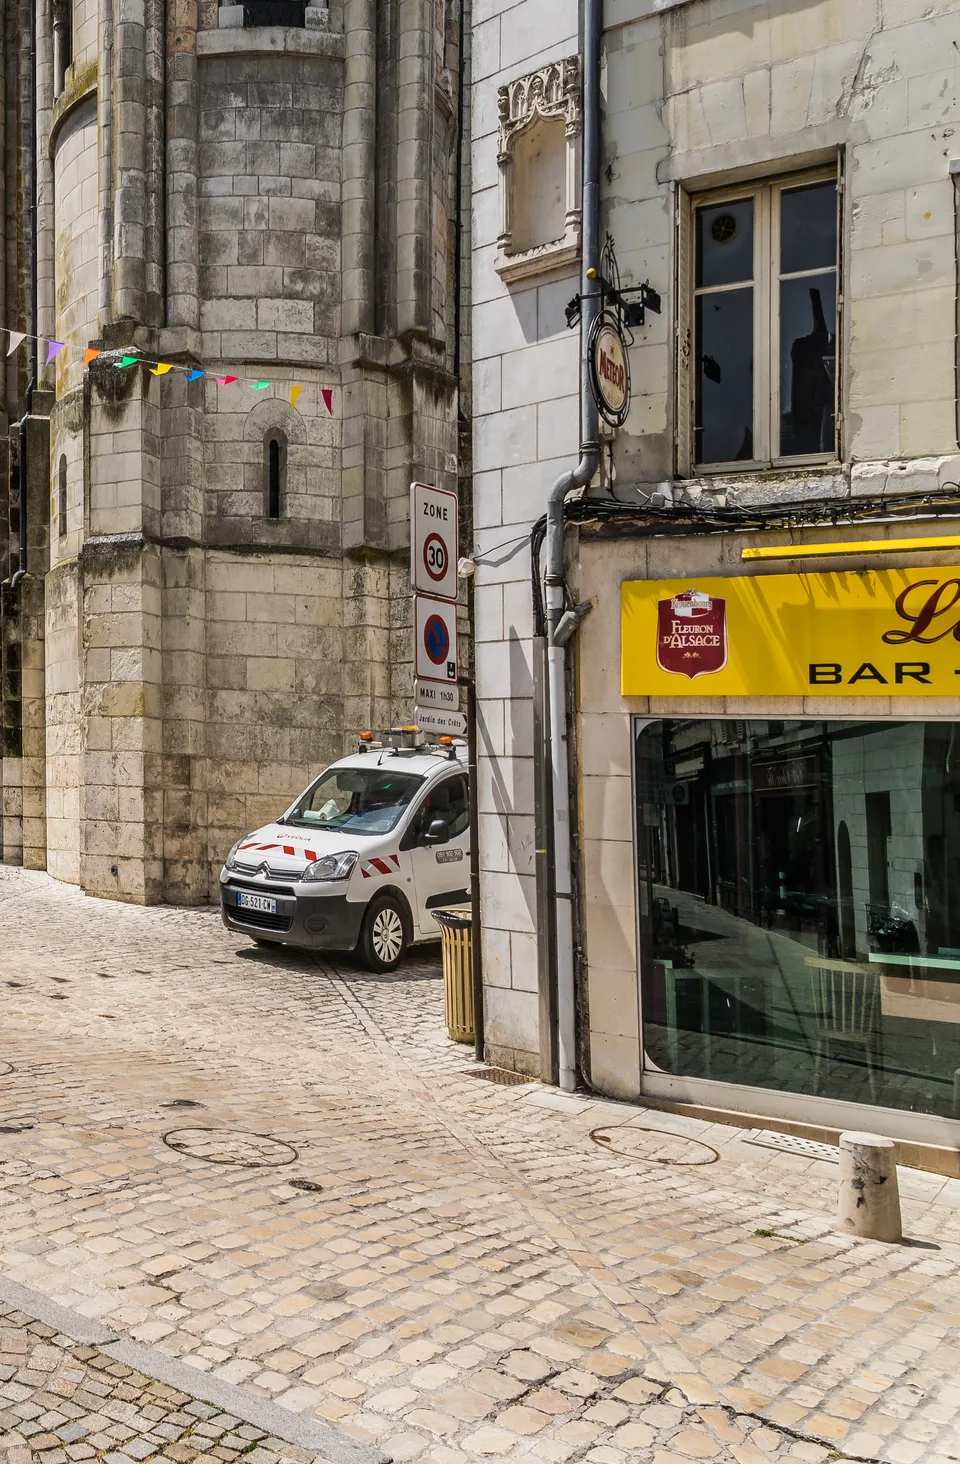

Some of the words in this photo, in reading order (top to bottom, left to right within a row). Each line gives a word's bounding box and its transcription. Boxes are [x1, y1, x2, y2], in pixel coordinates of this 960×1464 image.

[600, 348, 625, 394] METEOR
[423, 502, 448, 521] ZONE
[428, 545, 444, 569] 30
[670, 598, 713, 611] Kronenbourg
[882, 578, 960, 644] L
[671, 620, 714, 634] FLEURON
[808, 662, 933, 685] BAR
[420, 687, 436, 699] MAXI
[440, 691, 454, 702] 1h30
[419, 714, 436, 724] Jardin
[437, 717, 446, 725] des
